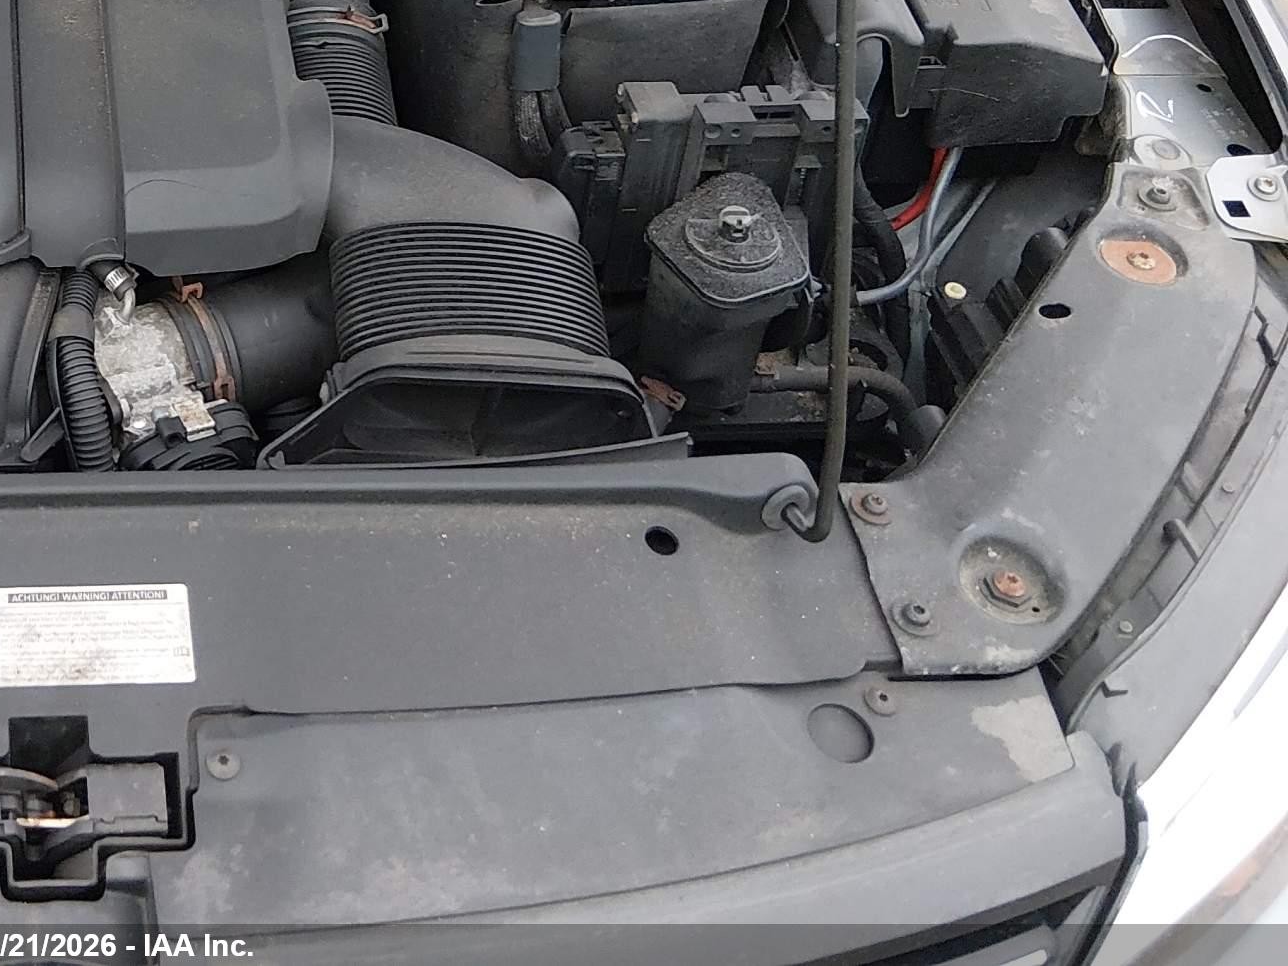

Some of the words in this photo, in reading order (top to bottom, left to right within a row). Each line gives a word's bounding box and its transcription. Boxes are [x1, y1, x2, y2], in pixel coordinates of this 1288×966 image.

[11, 592, 59, 603] ACHTUNG!
[62, 591, 109, 602] WARNING!
[112, 590, 165, 601] ATTENTION!
